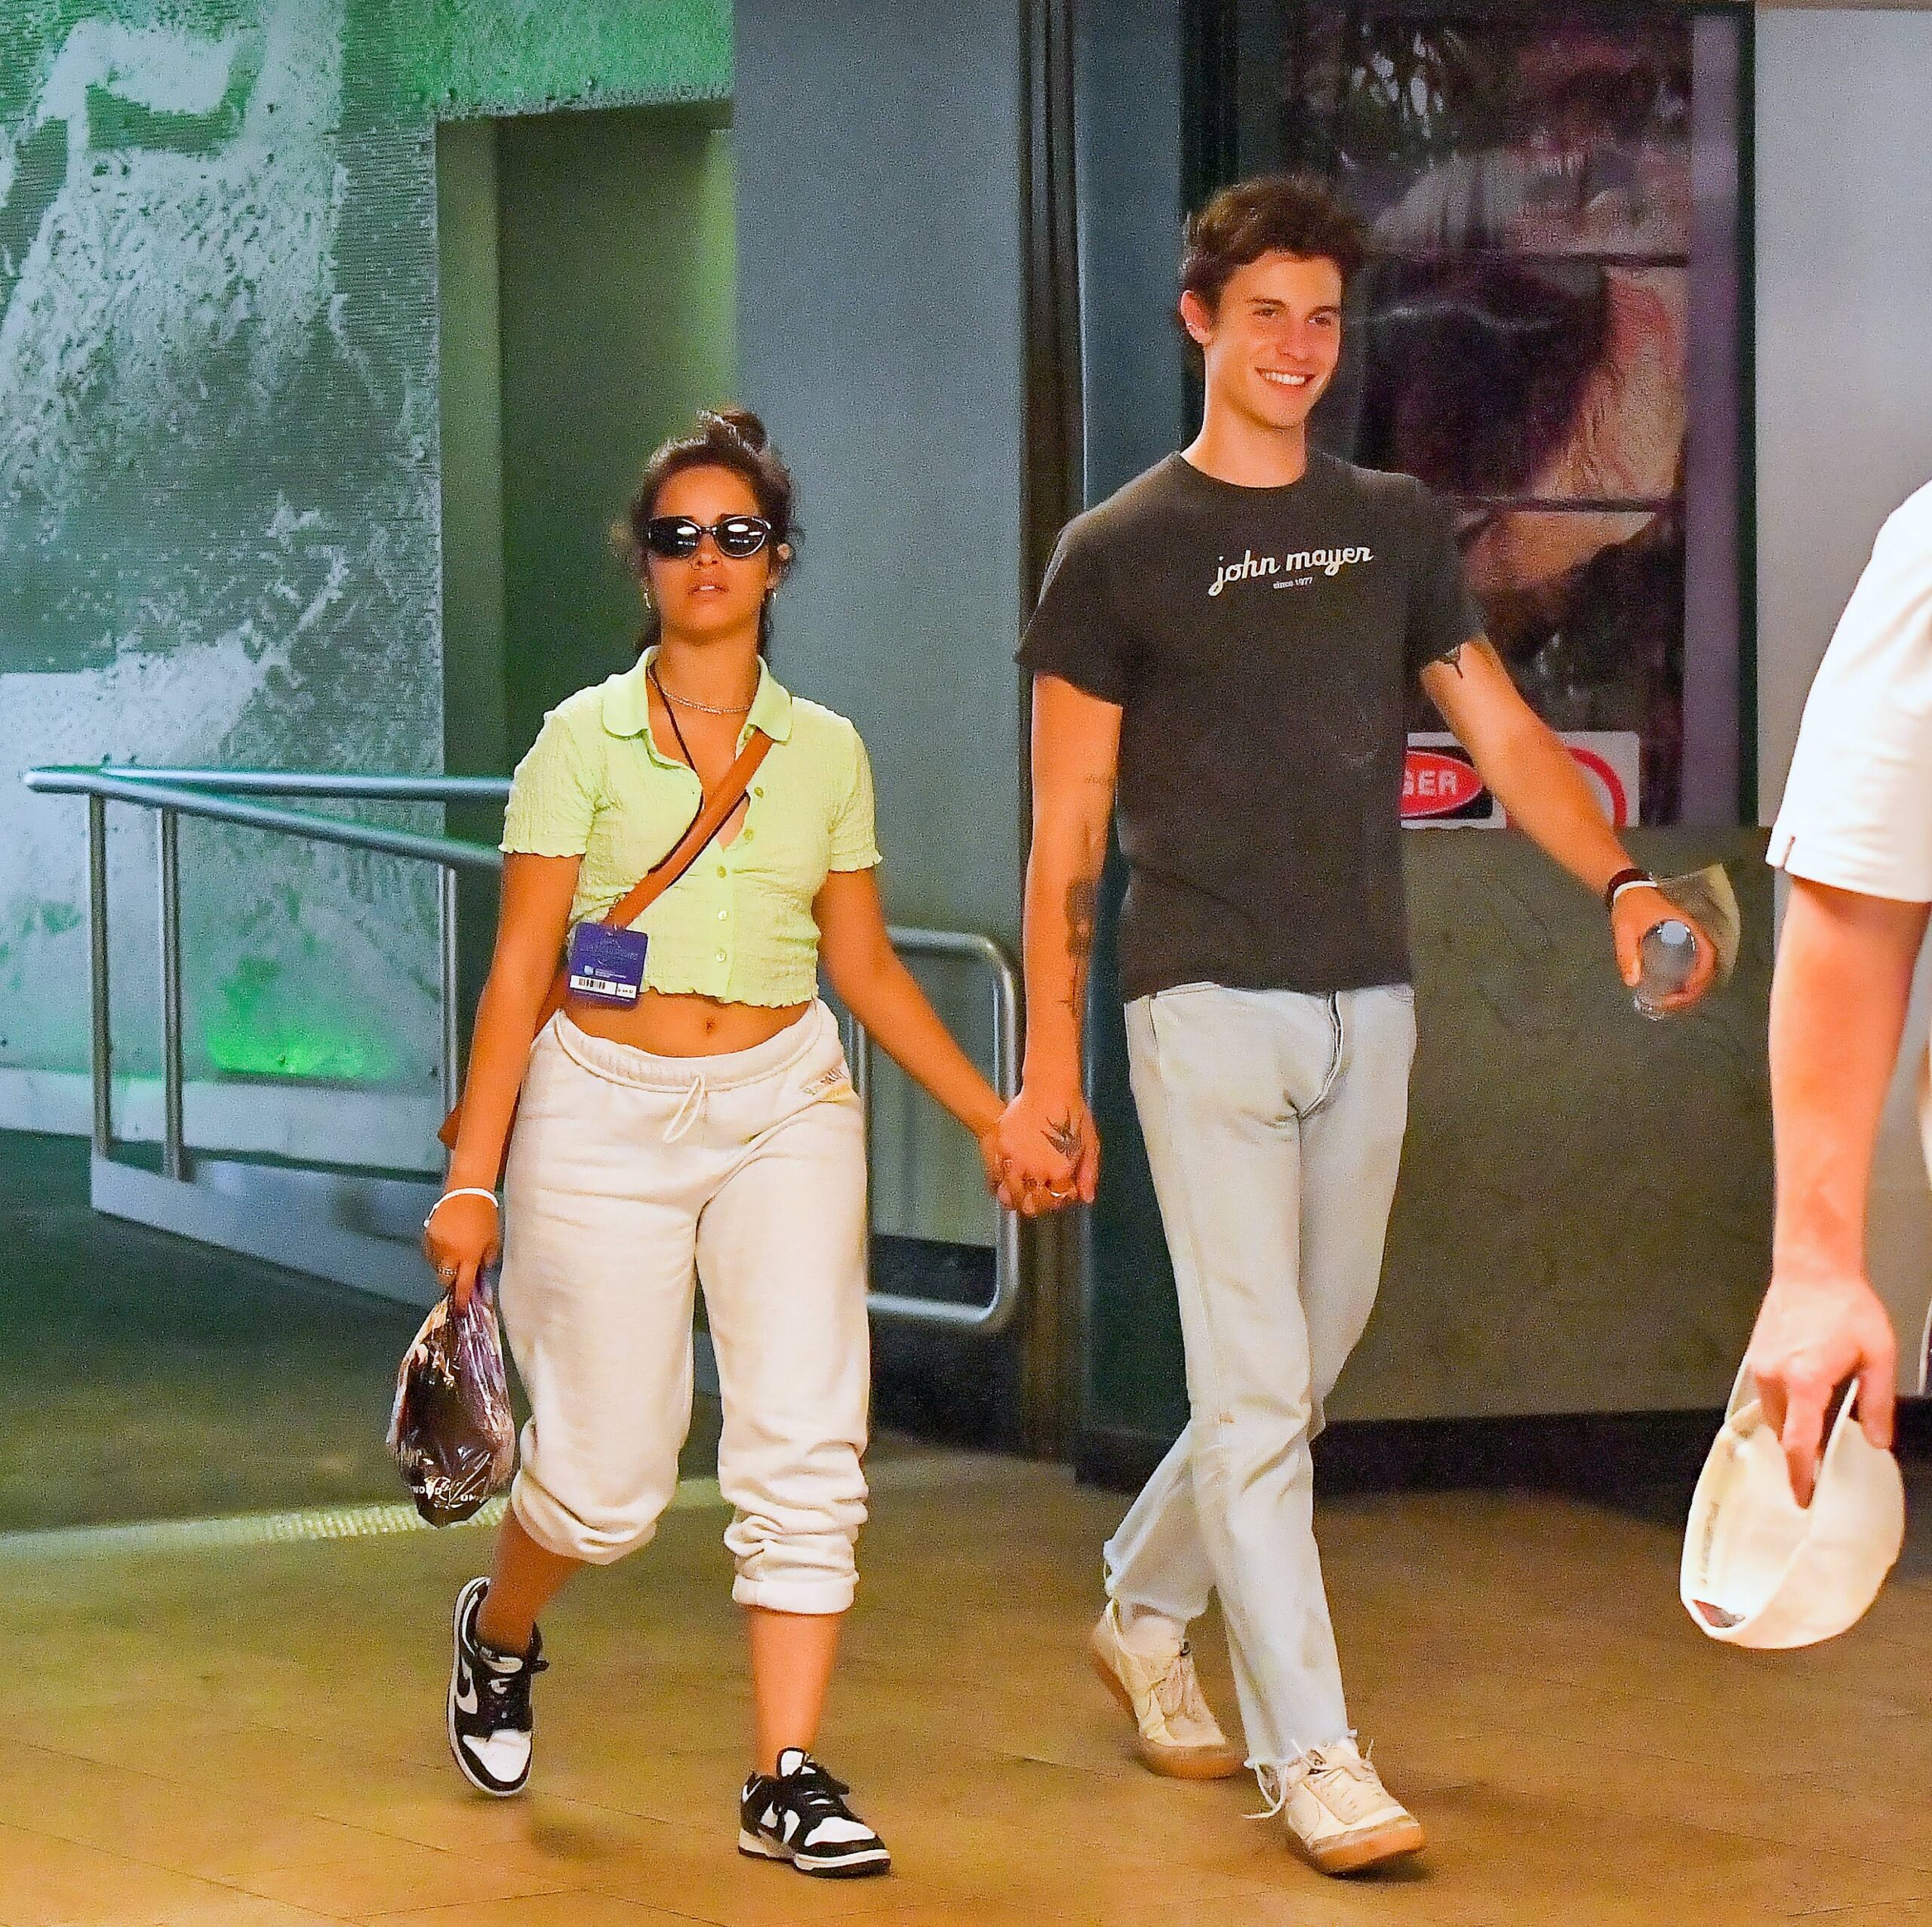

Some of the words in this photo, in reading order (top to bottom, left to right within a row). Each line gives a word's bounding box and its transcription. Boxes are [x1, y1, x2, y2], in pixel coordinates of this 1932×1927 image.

[1208, 549, 1281, 596] john
[1285, 547, 1374, 576] mayer
[1295, 577, 1313, 585] 1977
